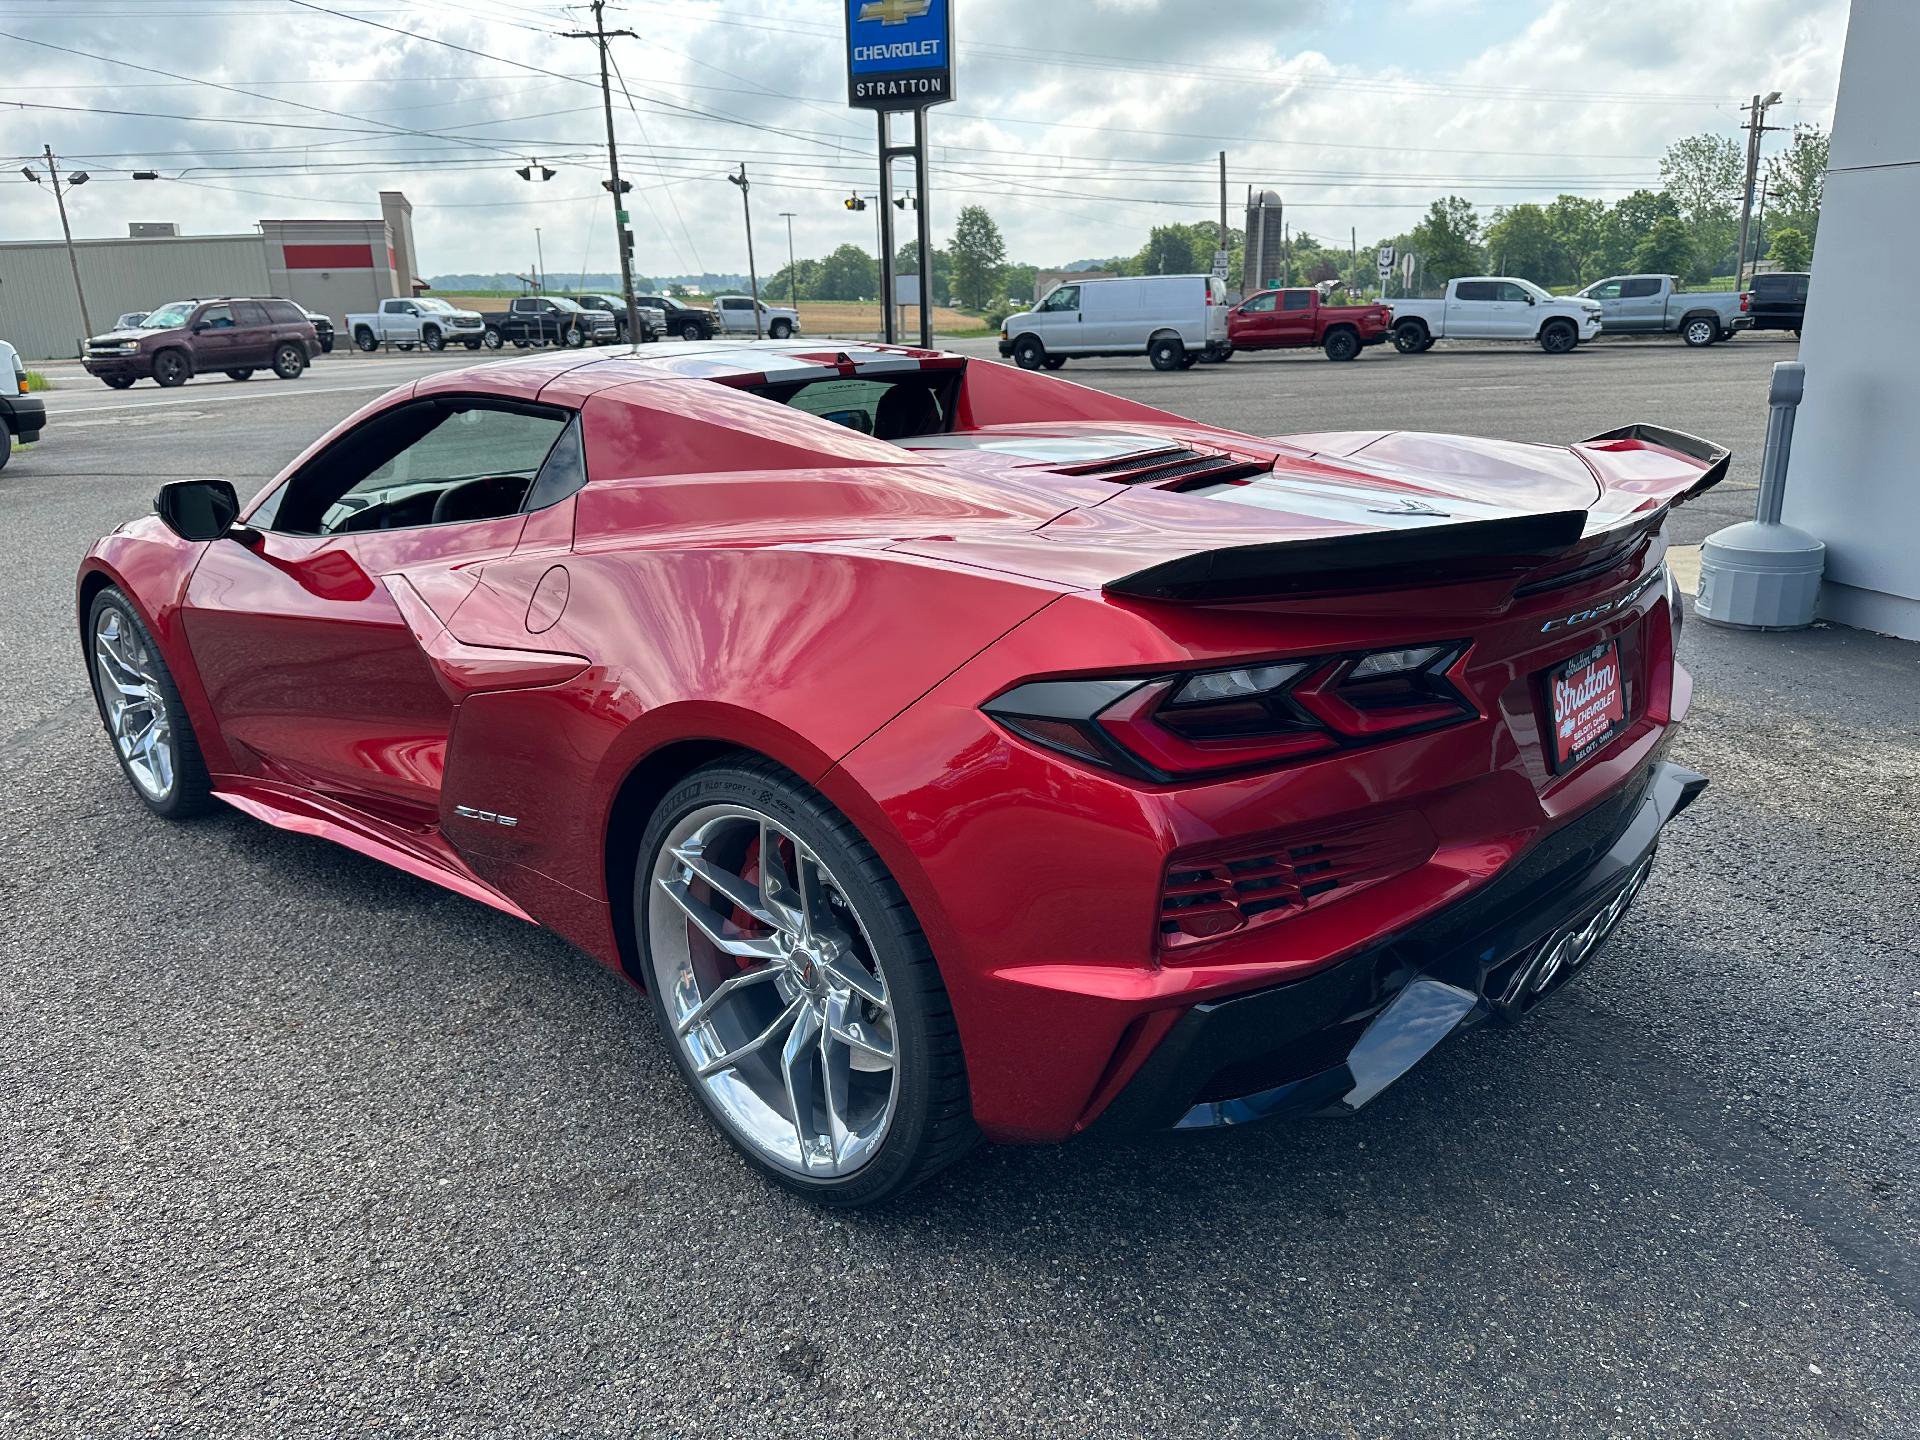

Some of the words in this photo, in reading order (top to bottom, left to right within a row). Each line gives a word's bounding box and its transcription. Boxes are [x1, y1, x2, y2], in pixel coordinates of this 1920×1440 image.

[854, 40, 940, 61] CHEVROLET
[856, 78, 941, 97] STRATTON
[1555, 663, 1616, 722] Stratton
[1577, 689, 1616, 726] CHEVROLET
[650, 783, 700, 825] MICHELIN
[724, 781, 747, 792] SPORT
